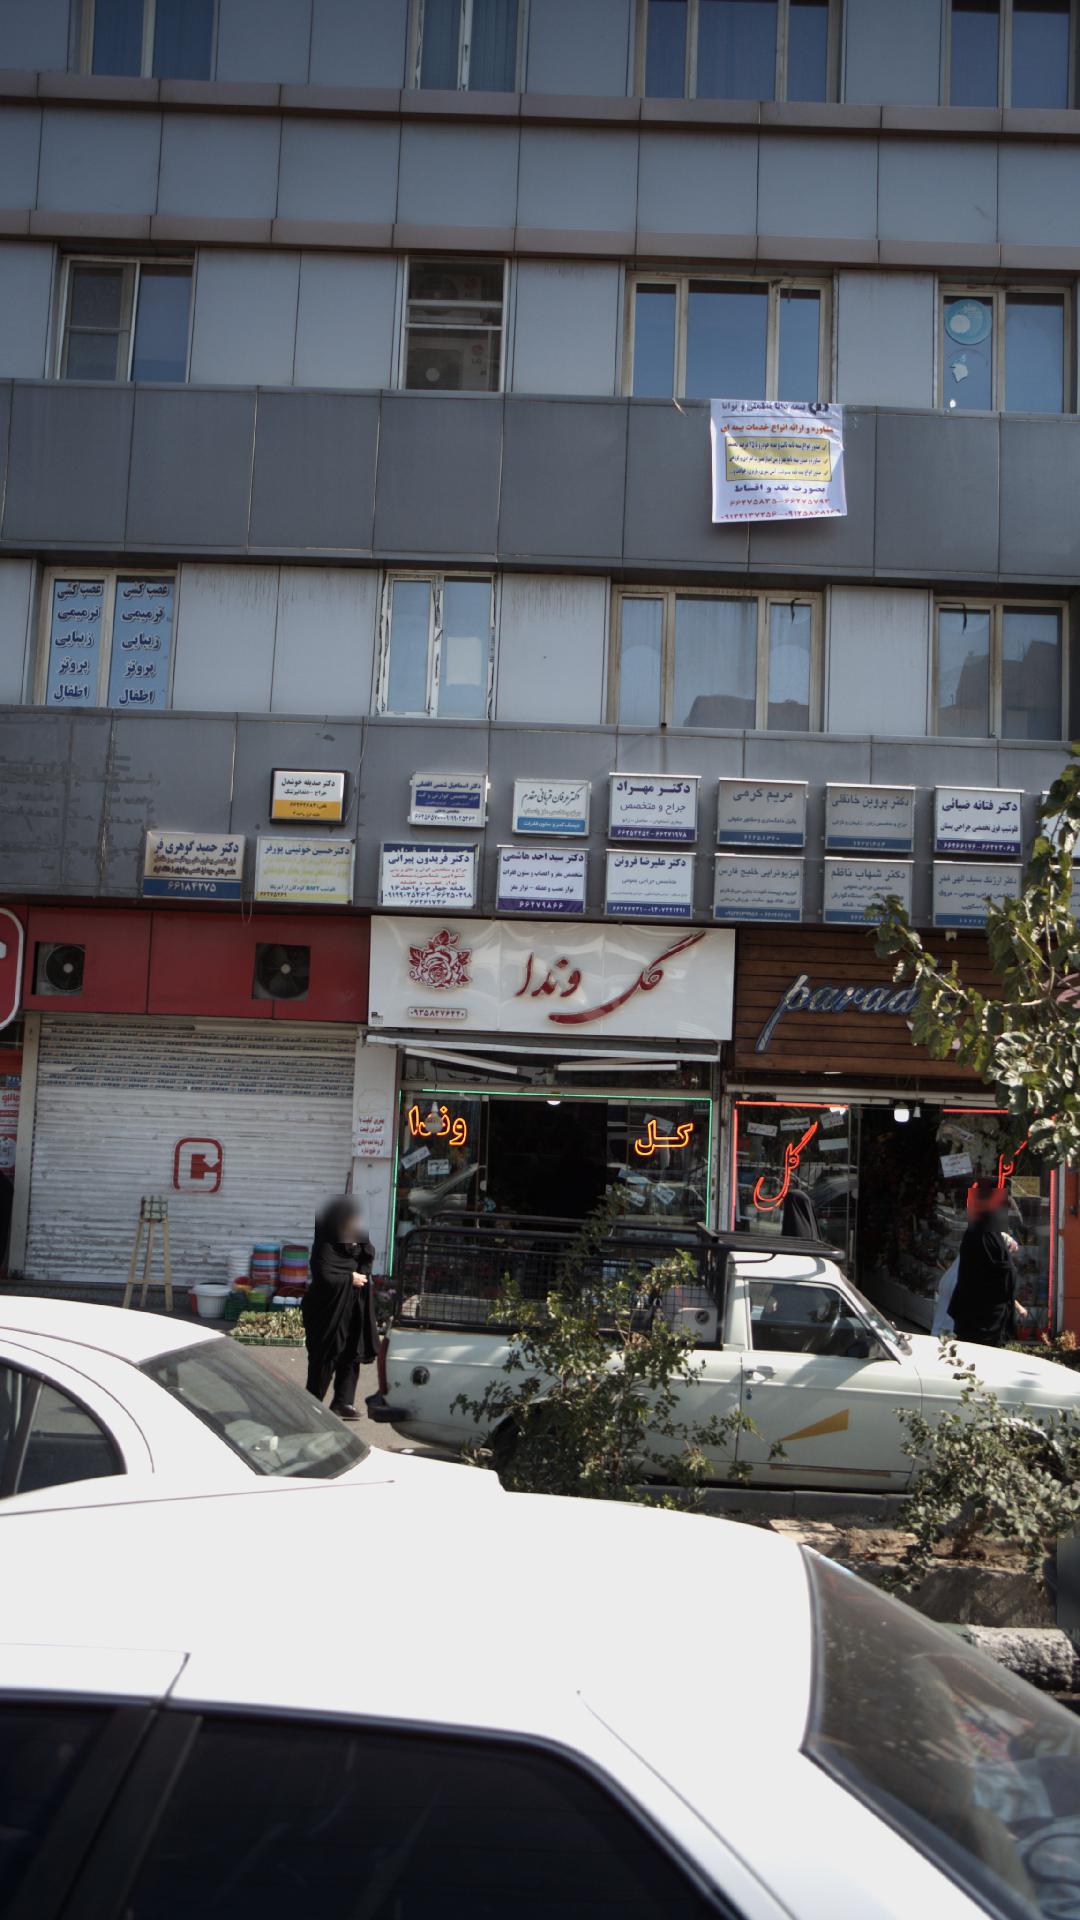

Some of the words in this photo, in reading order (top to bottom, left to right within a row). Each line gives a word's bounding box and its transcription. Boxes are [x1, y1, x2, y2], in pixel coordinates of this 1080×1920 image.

[57, 583, 79, 599] کشی
[80, 584, 103, 598] عصب
[123, 582, 146, 599] کشی
[147, 583, 168, 599] عصب
[58, 606, 101, 621] ترمیمی
[122, 606, 164, 623] ترمیمی
[55, 630, 94, 647] زیبایی
[122, 633, 161, 650] زیبایی
[59, 657, 88, 674] پروتز
[125, 660, 156, 677] پروتز
[54, 684, 88, 701] اطفال
[119, 689, 154, 705] اطفال
[733, 787, 763, 801] کرمی
[766, 790, 793, 803] مریم
[658, 804, 663, 812] و
[665, 802, 686, 815] جراح
[996, 801, 1018, 814] دکتر
[154, 837, 164, 855] فر
[196, 842, 218, 855] حمید
[219, 841, 239, 856] دکتر
[417, 853, 448, 865] فریدون
[450, 854, 470, 865] دکتر
[502, 851, 530, 862] هاشمی
[532, 852, 548, 861] احد
[549, 853, 564, 862] سید
[566, 853, 584, 863] دکتر
[614, 855, 638, 868] فروتن
[640, 856, 665, 868] علیرضا
[668, 858, 686, 869] دکتر
[719, 867, 738, 877] فارس
[761, 868, 800, 879] فیزیوتراپی
[855, 868, 882, 881] شهاب
[885, 869, 906, 881] دکتر
[514, 952, 583, 998] وندا
[548, 931, 706, 1025] گل
[753, 1120, 819, 1212] گل
